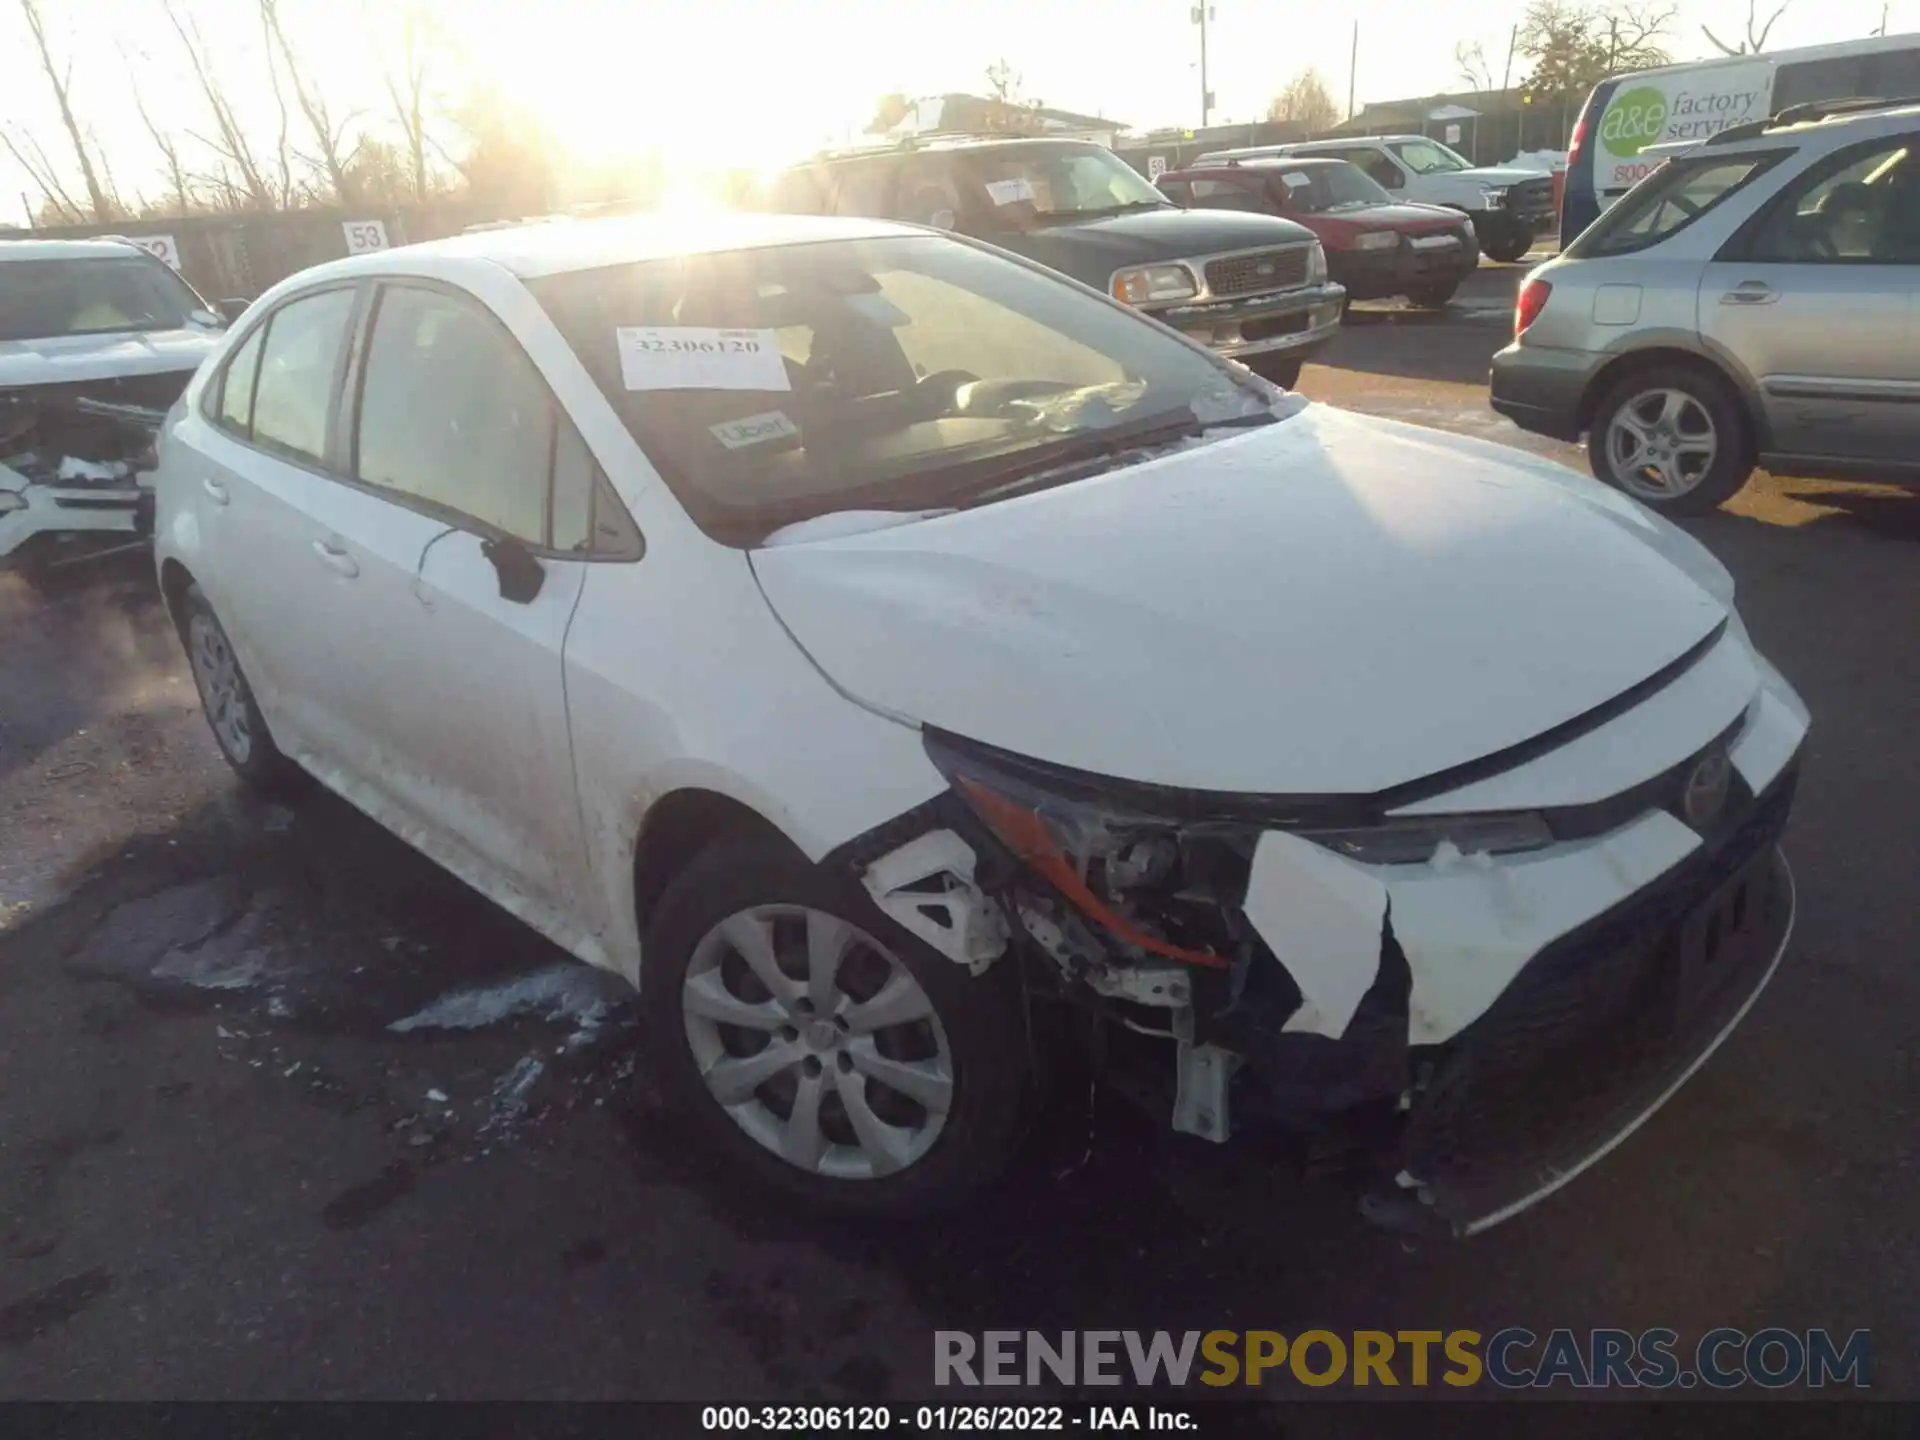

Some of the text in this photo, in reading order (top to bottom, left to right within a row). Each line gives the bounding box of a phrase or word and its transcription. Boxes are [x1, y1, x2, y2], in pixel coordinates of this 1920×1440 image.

[1671, 91, 1758, 116] factory
[1603, 104, 1666, 141] a&e
[351, 226, 381, 248] 53
[635, 339, 760, 354] 32306120
[719, 417, 785, 443] Uber
